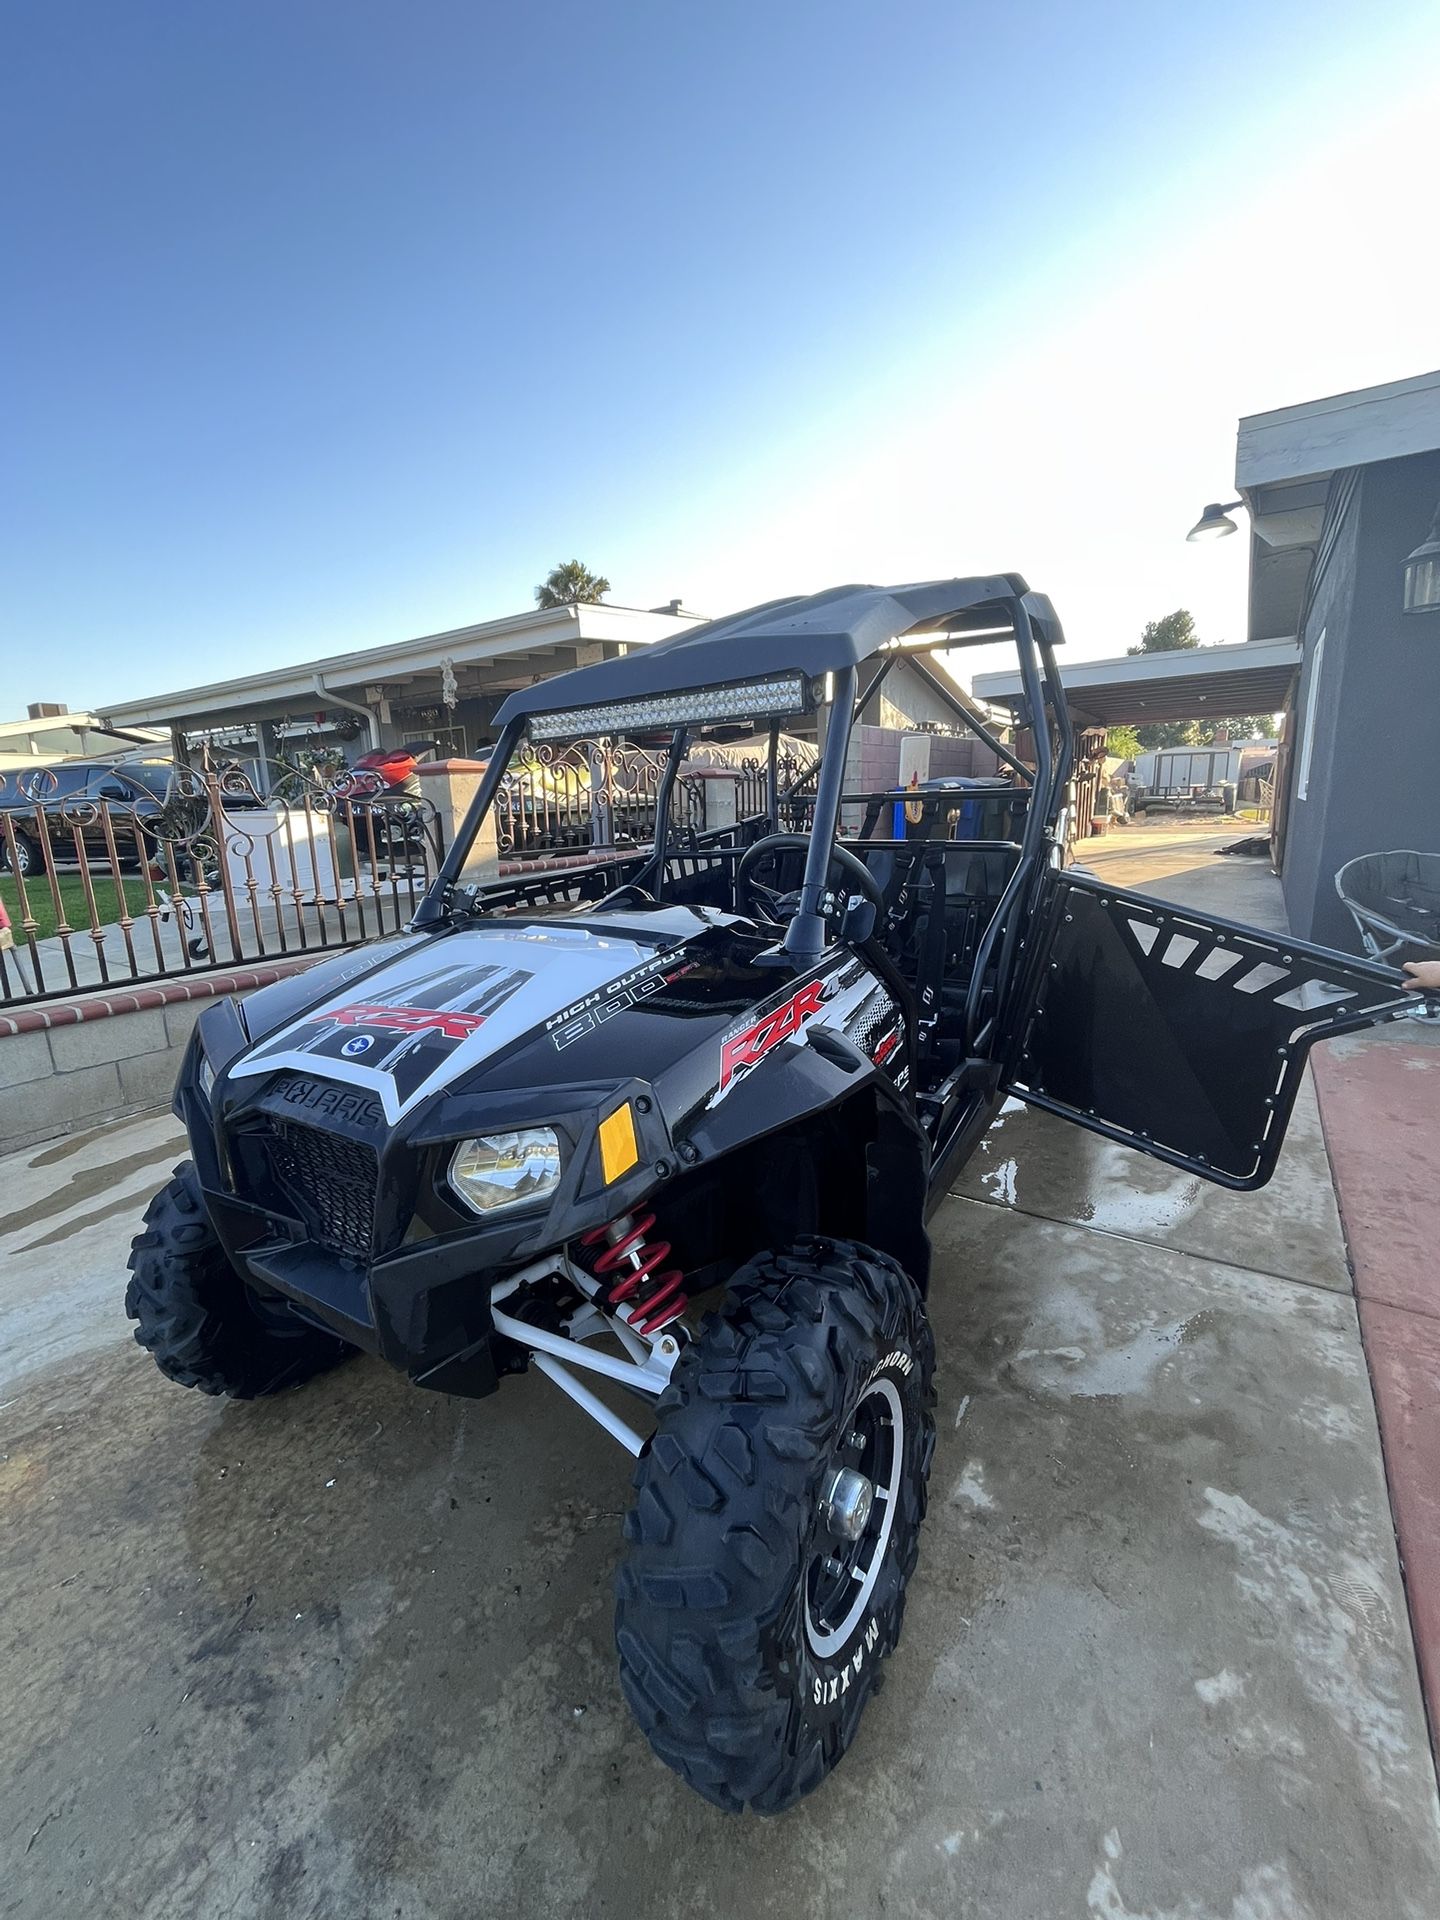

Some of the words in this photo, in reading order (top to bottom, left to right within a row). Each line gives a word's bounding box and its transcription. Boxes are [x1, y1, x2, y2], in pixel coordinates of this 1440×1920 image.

[308, 1004, 488, 1040] RZR
[546, 992, 600, 1030] HIGH
[606, 946, 687, 994] OUTPUT
[551, 973, 668, 1051] 800
[720, 978, 827, 1094] RZR
[721, 1015, 757, 1043] RANGER
[266, 1079, 383, 1127] POLARIS
[813, 1616, 880, 1706] MAXXIS
